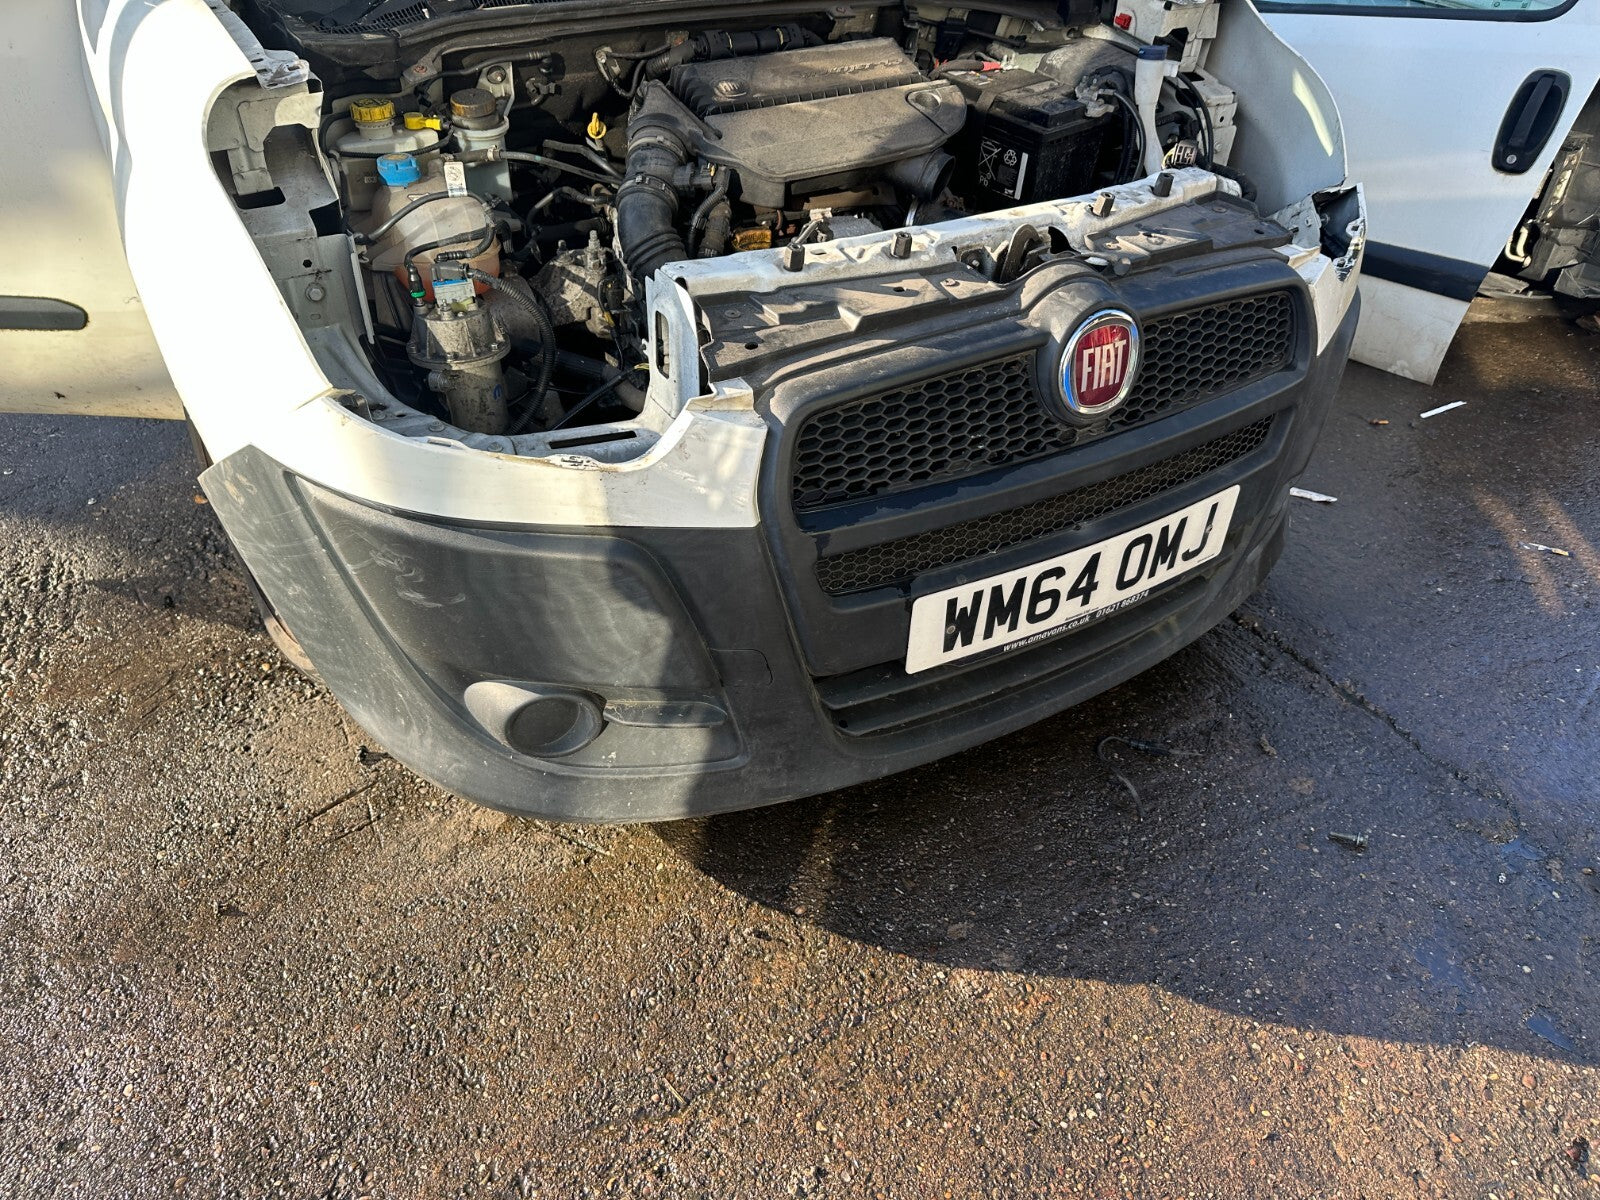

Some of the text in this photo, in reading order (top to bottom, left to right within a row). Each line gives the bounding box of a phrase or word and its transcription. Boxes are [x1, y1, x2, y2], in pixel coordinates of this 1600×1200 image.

[1081, 339, 1126, 393] FIAT
[942, 502, 1219, 653] WM64 OMJ
[1003, 614, 1090, 652] www.amavans.co.uk
[1096, 604, 1120, 618] 01621
